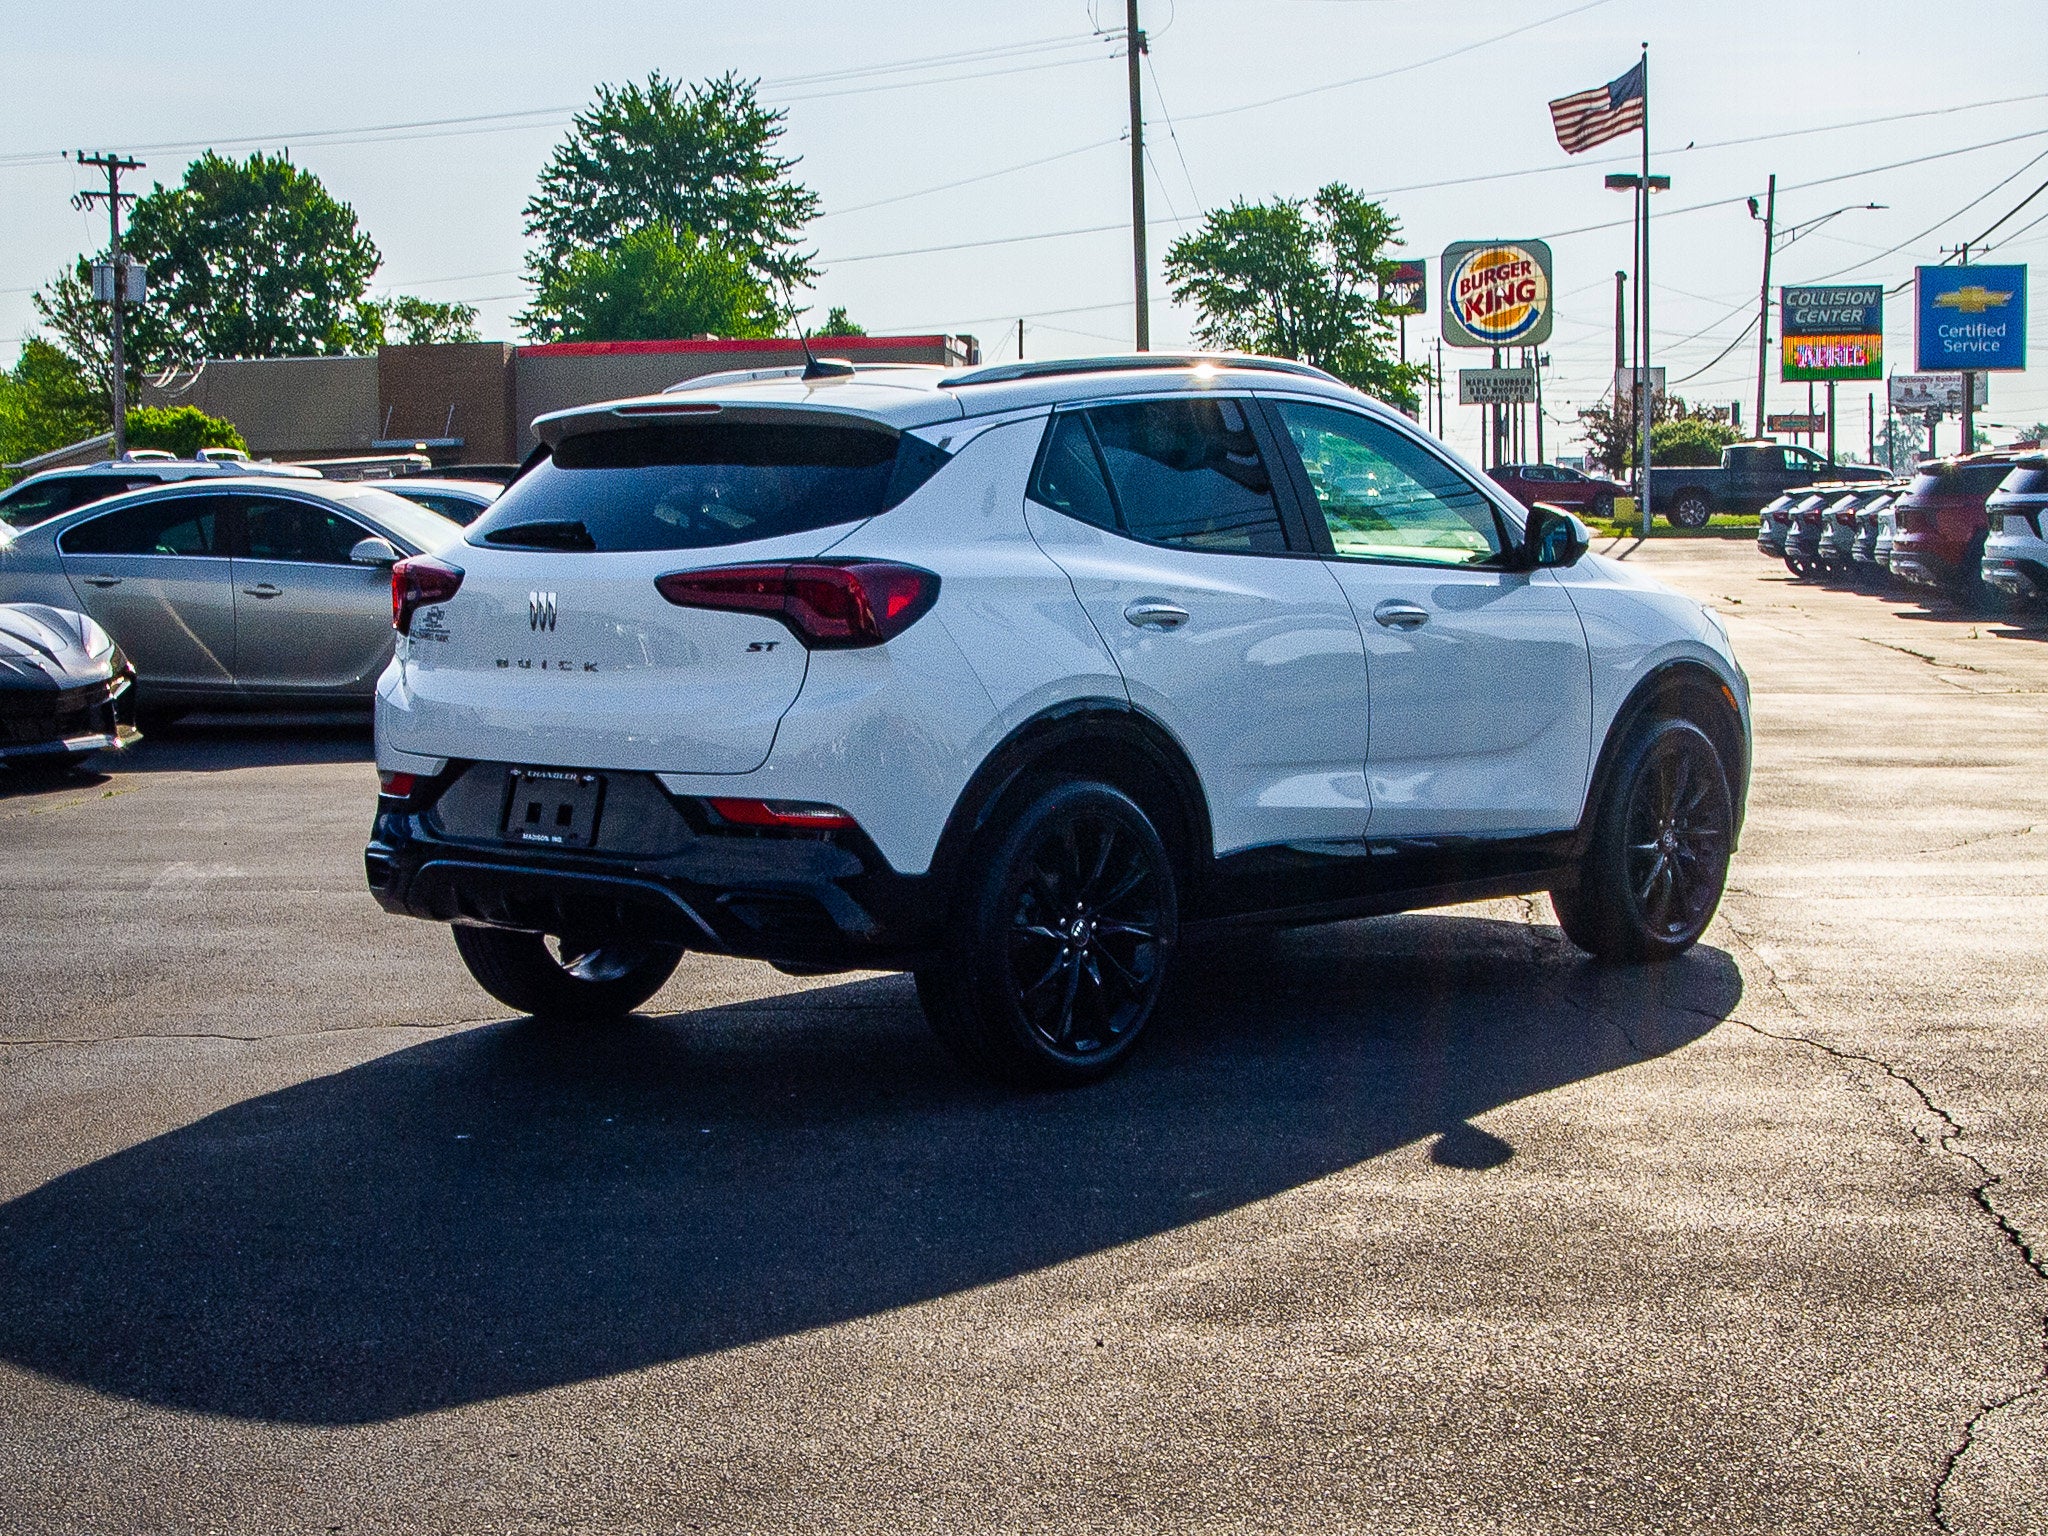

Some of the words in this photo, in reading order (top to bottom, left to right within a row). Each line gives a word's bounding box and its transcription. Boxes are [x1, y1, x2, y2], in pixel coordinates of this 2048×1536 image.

[1460, 260, 1532, 297] BURGER
[1465, 279, 1536, 323] KING
[1786, 290, 1877, 306] COLLISION
[1795, 309, 1864, 324] CENTER
[1938, 323, 2006, 338] Certified
[1943, 339, 2000, 353] Service
[1465, 379, 1491, 387] MAPLE
[1493, 378, 1532, 386] BOURBON
[1492, 386, 1530, 395] WHOPPER
[1473, 395, 1511, 403] WHOPPER
[745, 641, 781, 653] ST
[496, 658, 599, 673] BUICK
[527, 770, 578, 780] CHANDLER
